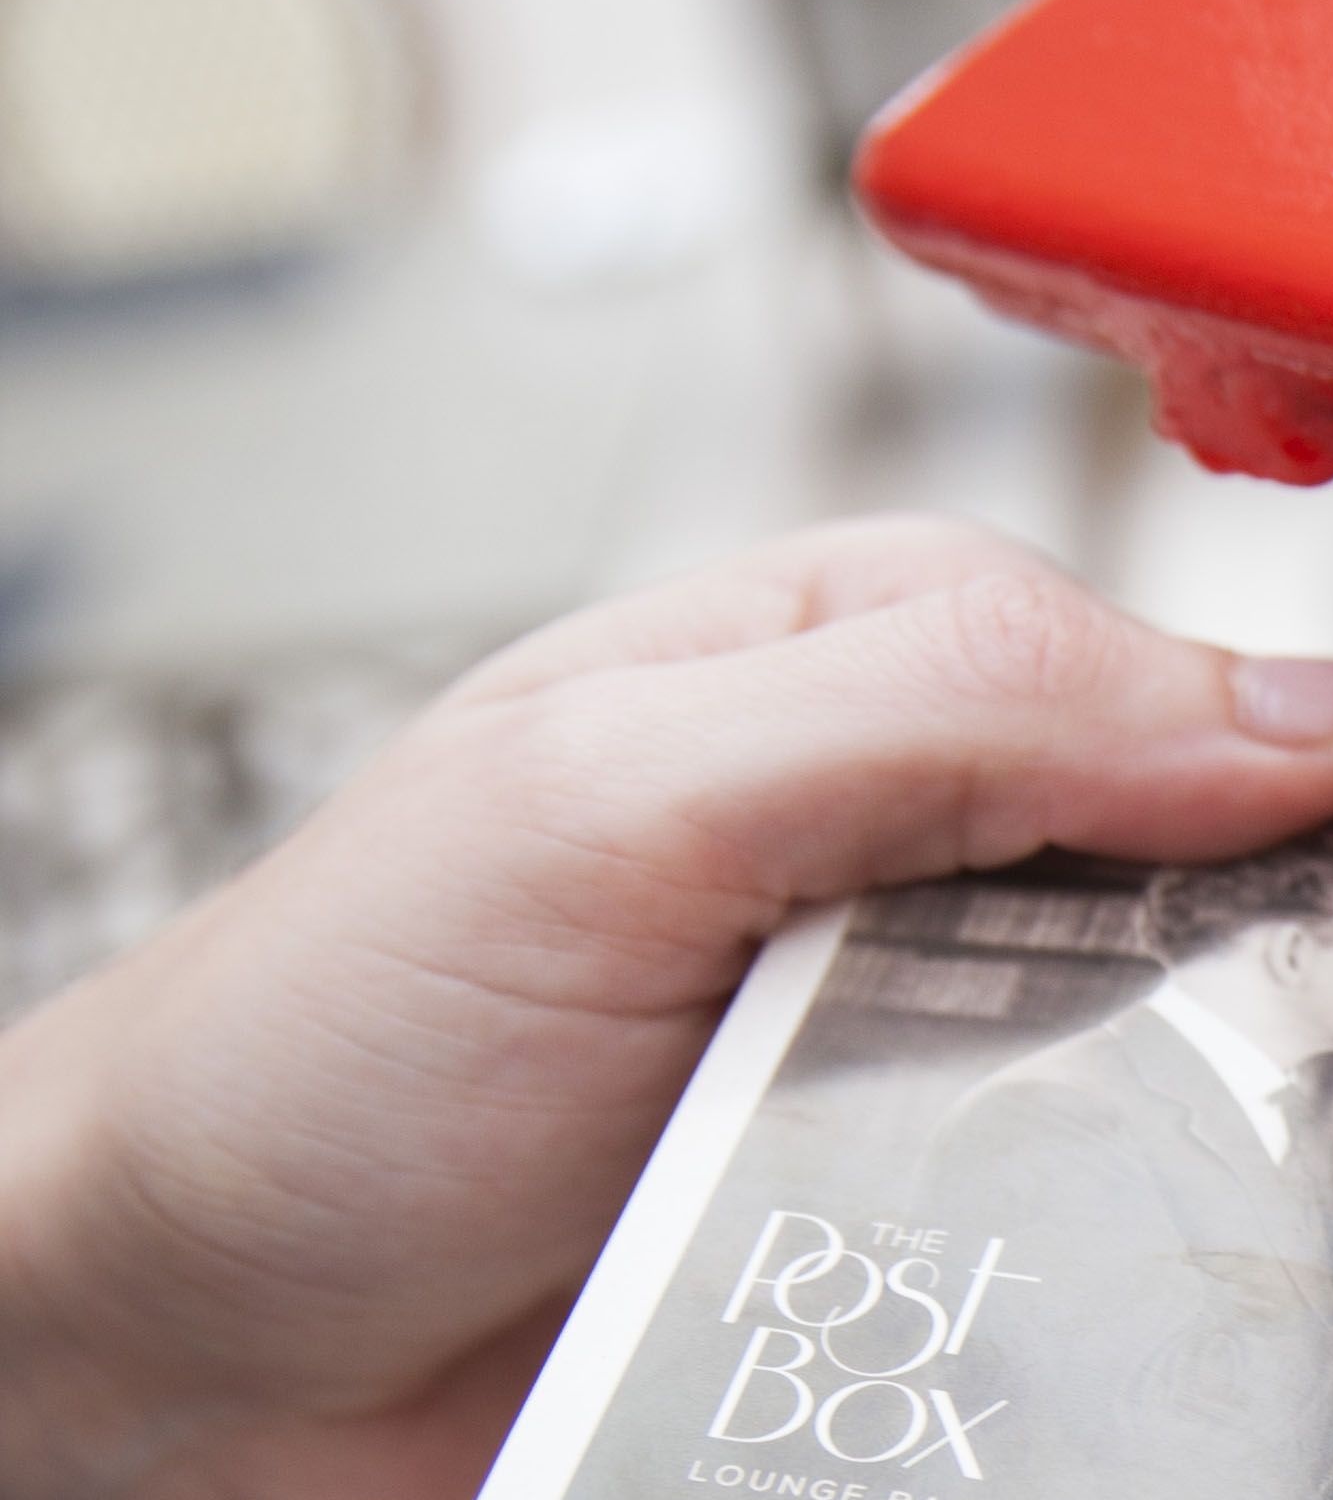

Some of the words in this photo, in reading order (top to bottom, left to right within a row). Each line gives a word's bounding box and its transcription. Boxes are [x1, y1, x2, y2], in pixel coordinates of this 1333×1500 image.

[720, 1208, 1043, 1378] POST
[871, 1220, 950, 1255] THE
[706, 1324, 1010, 1481] BOX
